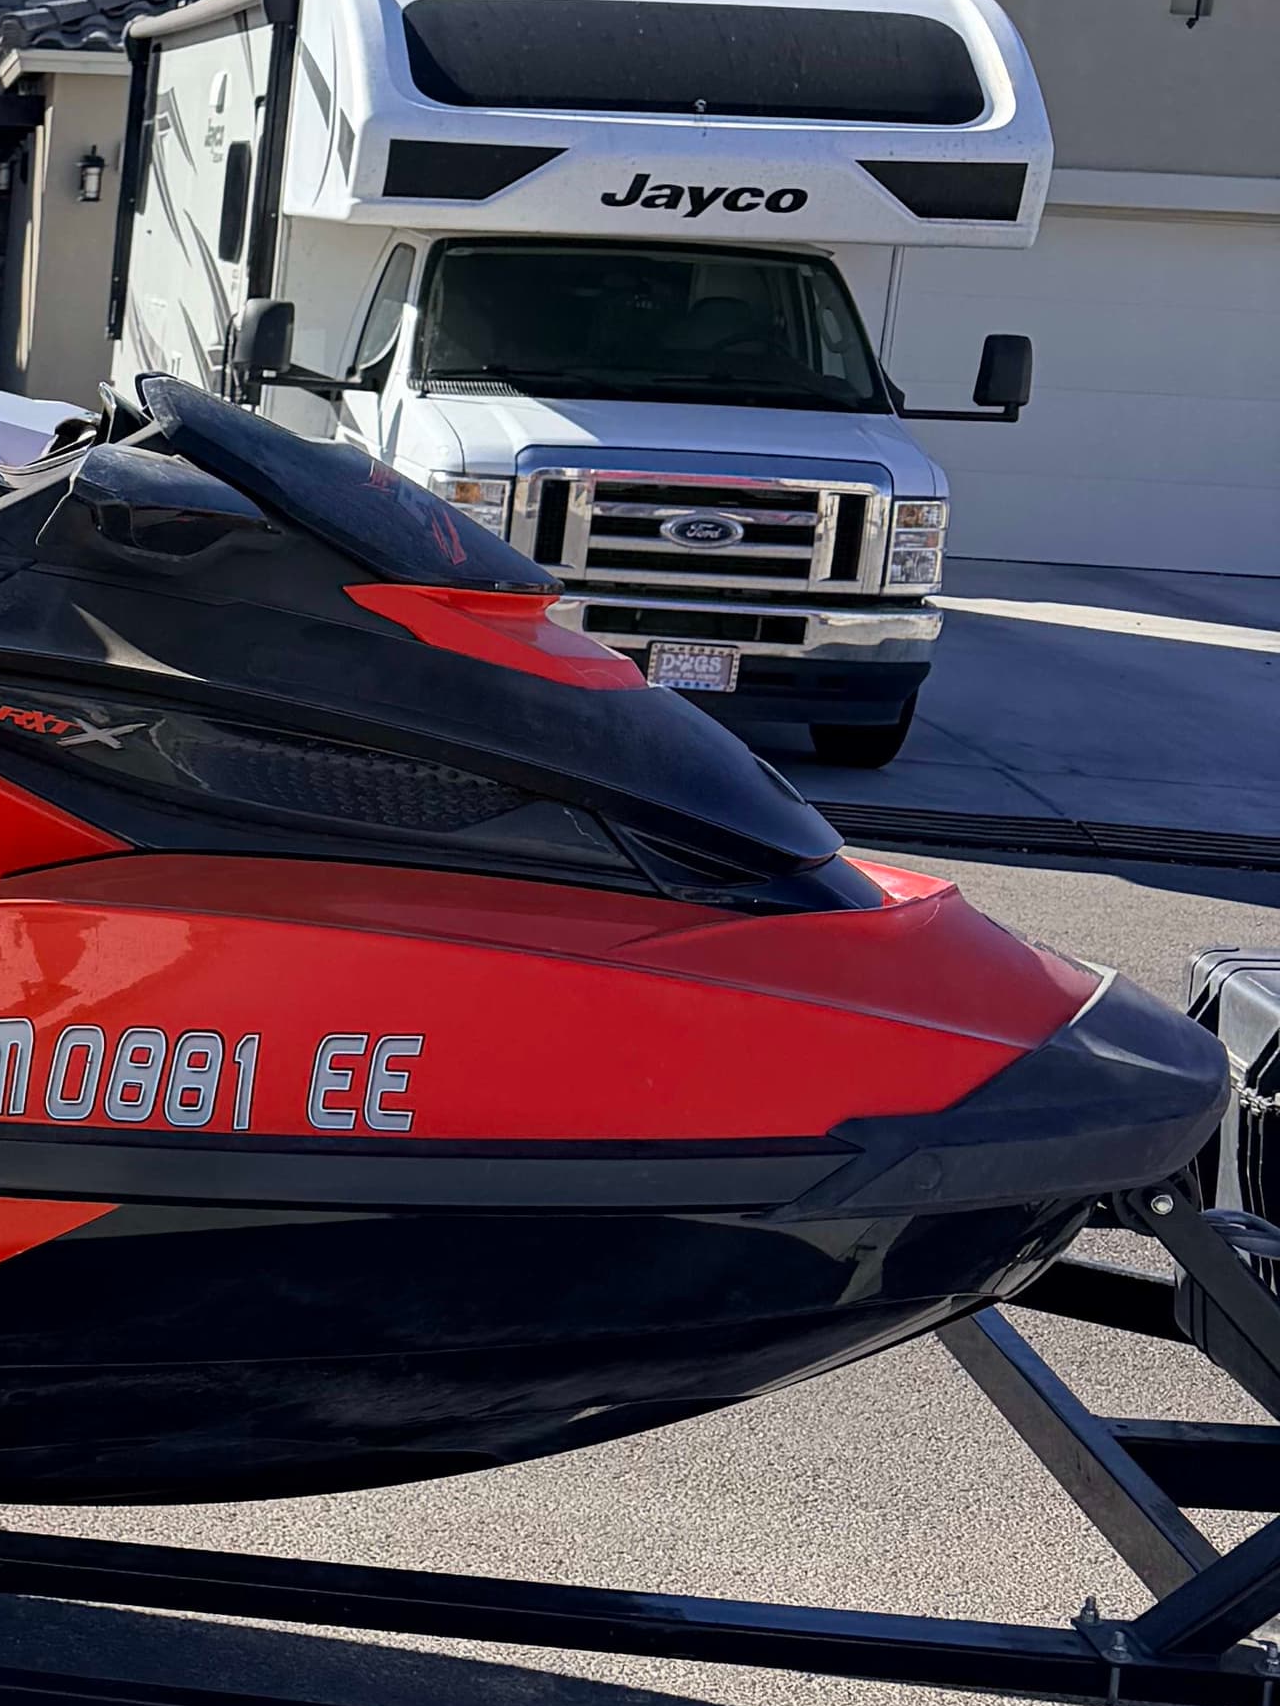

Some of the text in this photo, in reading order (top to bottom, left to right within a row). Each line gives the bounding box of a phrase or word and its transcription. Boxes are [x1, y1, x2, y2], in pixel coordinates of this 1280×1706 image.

[600, 172, 809, 218] Jayco
[686, 523, 723, 539] Ford
[43, 1024, 261, 1132] 0881
[306, 1032, 426, 1132] EE
